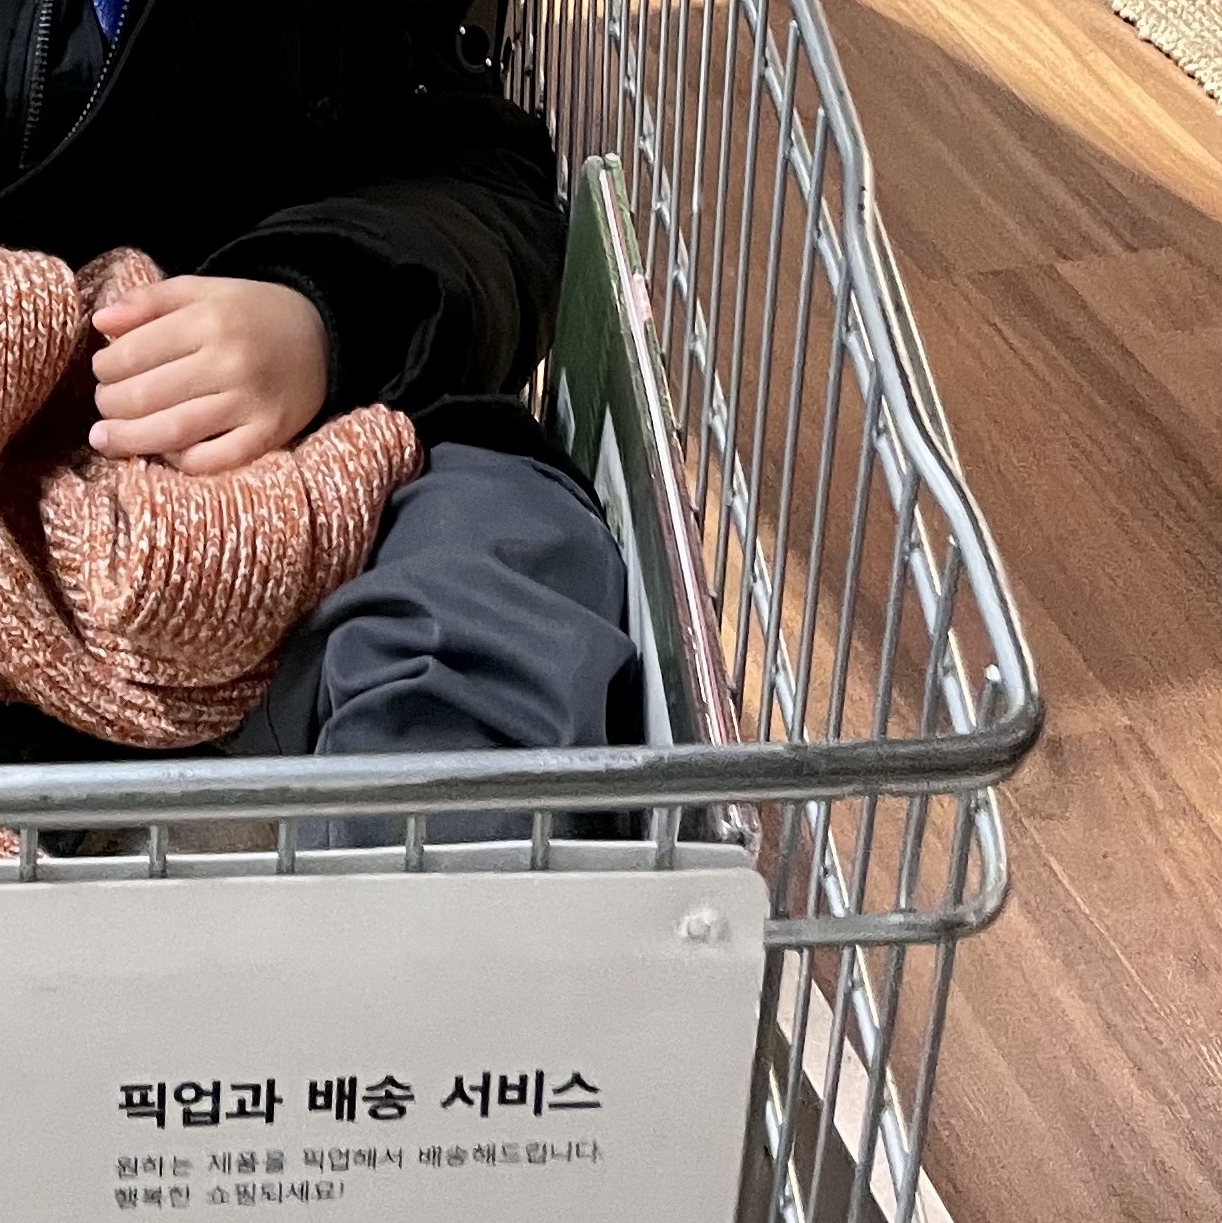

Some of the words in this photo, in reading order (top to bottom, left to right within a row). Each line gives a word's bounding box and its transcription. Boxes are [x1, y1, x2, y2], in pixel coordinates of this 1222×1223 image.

[118, 1077, 284, 1130] 픽업과
[307, 1075, 415, 1123] 배송
[439, 1068, 602, 1119] 서비스
